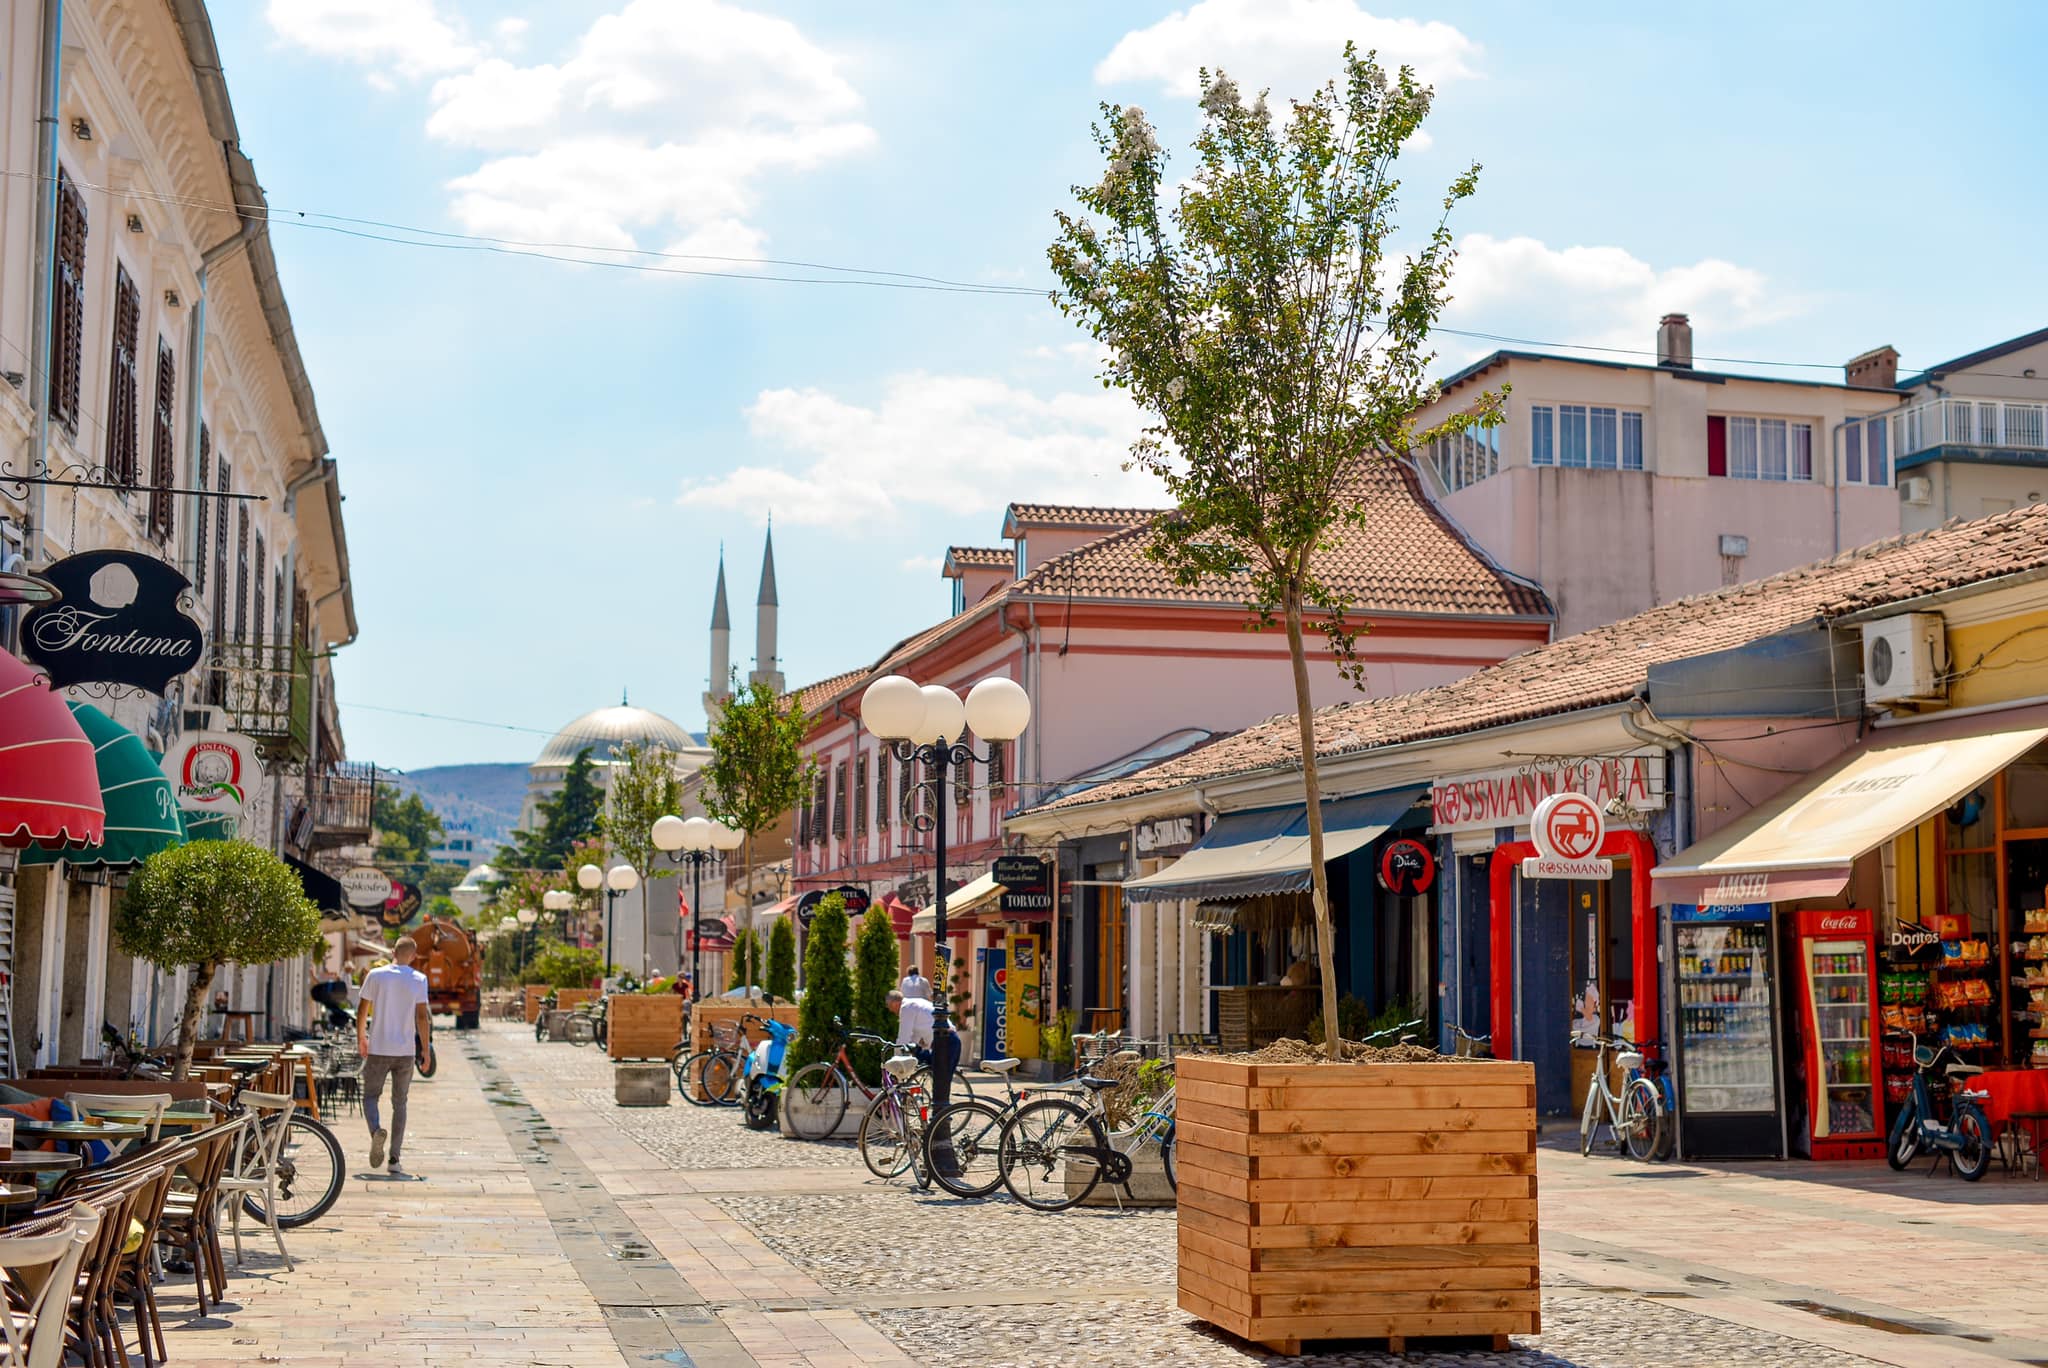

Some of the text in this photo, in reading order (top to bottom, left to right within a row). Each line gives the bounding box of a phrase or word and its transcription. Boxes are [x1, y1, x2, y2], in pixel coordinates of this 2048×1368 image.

[33, 606, 192, 656] Fontana
[195, 743, 234, 755] FONTANA
[1432, 768, 1557, 825] ROSSMANN
[1538, 861, 1608, 875] ROSSMANN
[1715, 873, 1769, 899] AMSTEL
[1006, 895, 1051, 908] TOBACCO
[1891, 932, 1940, 946] Doritos
